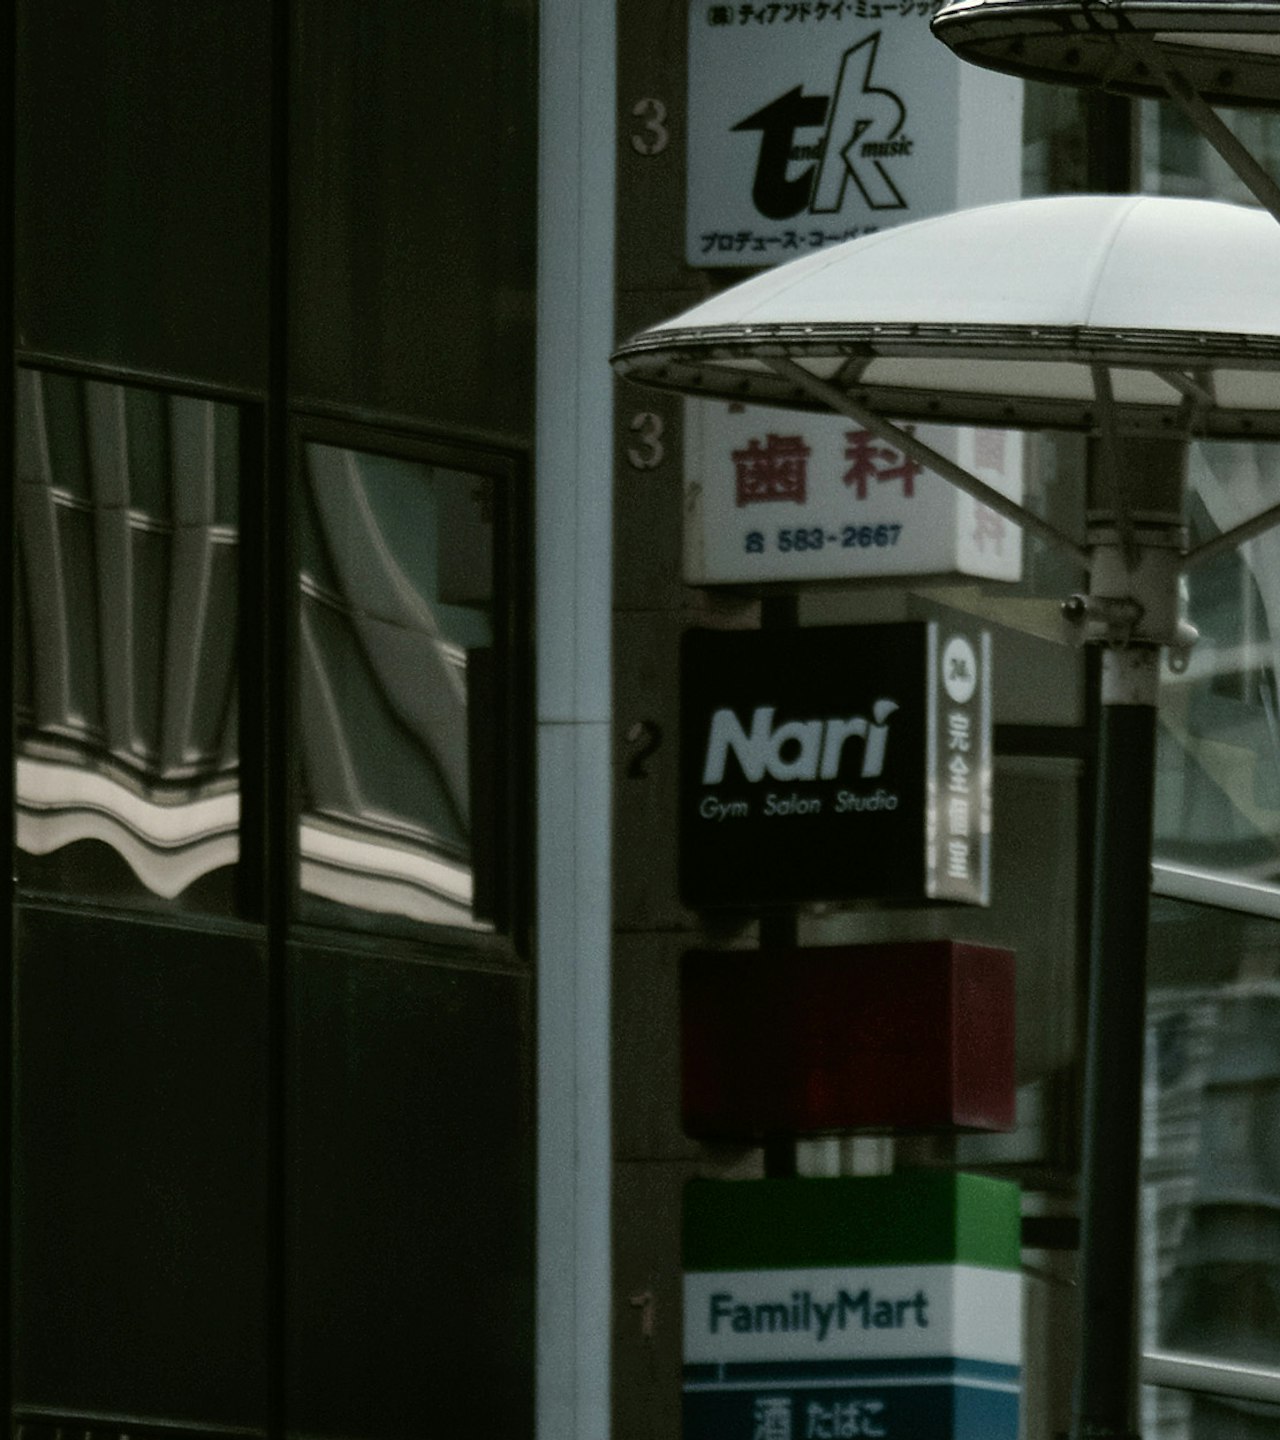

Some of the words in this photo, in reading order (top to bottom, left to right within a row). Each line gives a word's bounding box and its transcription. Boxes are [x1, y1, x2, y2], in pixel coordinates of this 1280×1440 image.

[632, 98, 669, 156] 3
[628, 411, 665, 470] 3
[778, 524, 903, 553] 583-2667
[702, 696, 900, 786] Nari
[700, 794, 750, 823] Gym
[763, 792, 821, 818] Salon
[834, 787, 899, 814] Studio
[709, 1289, 929, 1342] FamilyMart
[805, 1399, 887, 1440] たばこ
